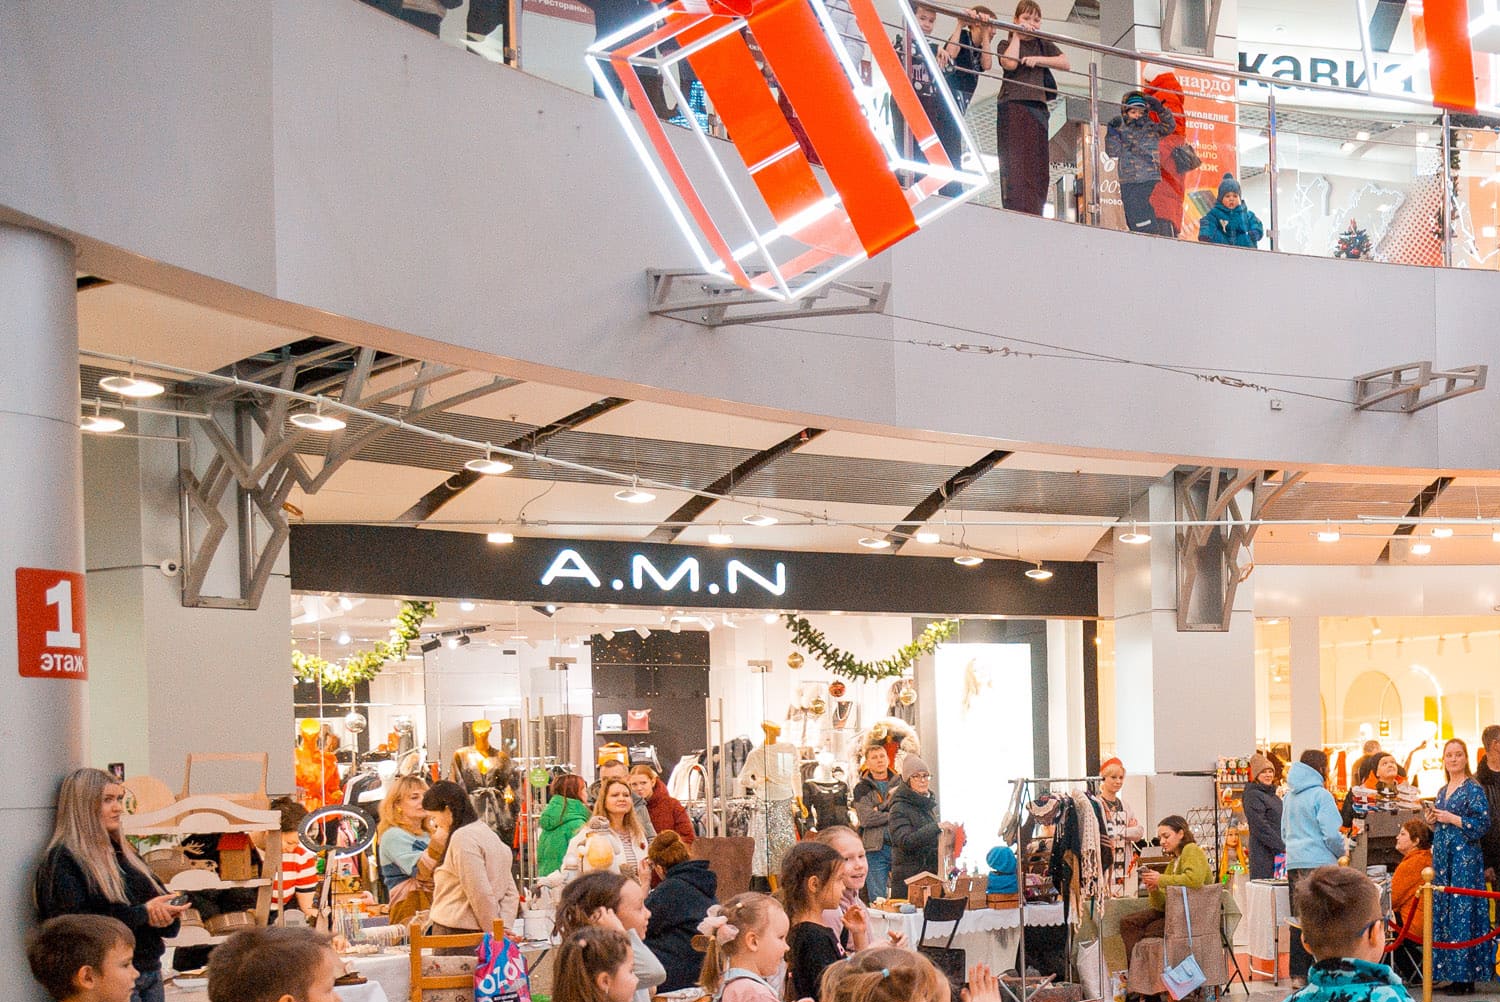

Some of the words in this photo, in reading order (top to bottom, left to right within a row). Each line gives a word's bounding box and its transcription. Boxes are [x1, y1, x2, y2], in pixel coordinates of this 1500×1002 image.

[1176, 75, 1231, 92] нардо
[541, 549, 786, 597] A.M.N
[46, 580, 81, 648] 1
[40, 653, 85, 673] этаж
